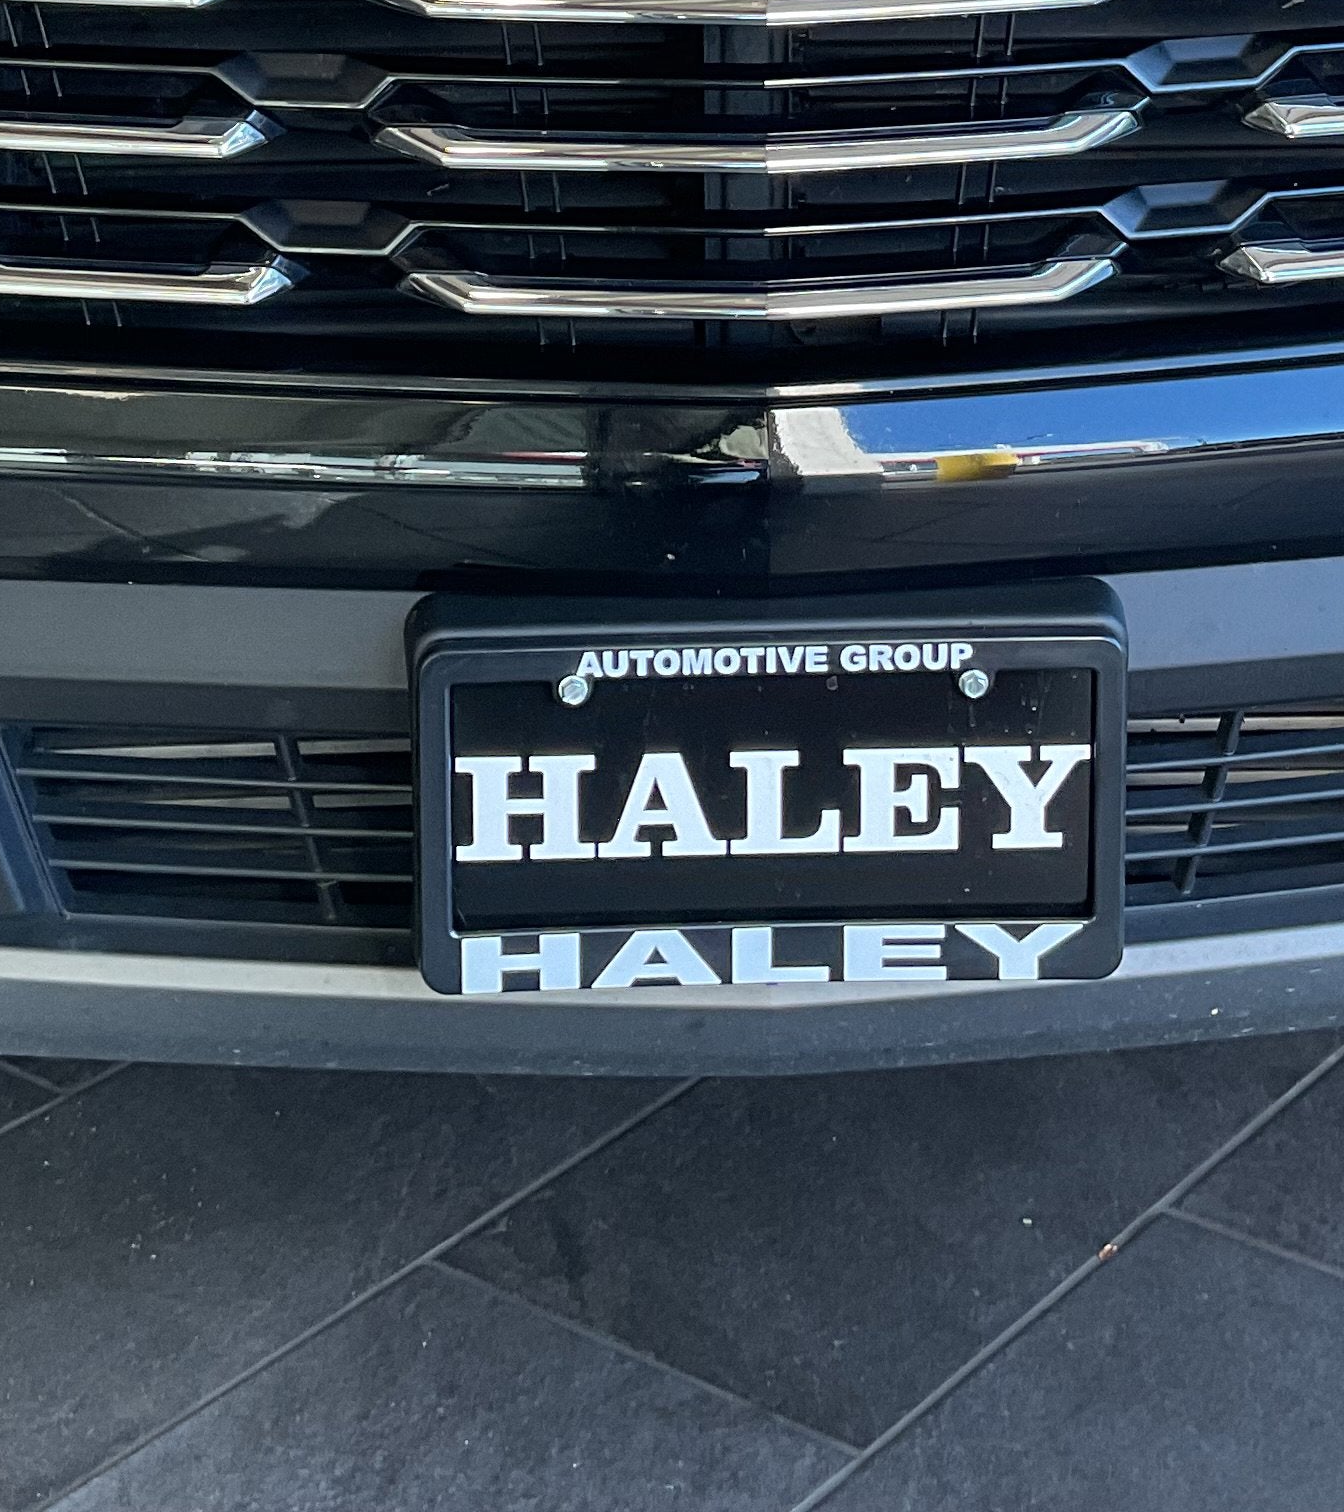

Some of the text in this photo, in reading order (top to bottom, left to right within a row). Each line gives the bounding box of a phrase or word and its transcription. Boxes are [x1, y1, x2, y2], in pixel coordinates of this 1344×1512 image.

[576, 643, 974, 678] AUTOMOTIVE GROUP
[455, 744, 1091, 862] HALEY
[460, 923, 1085, 995] HALEY
